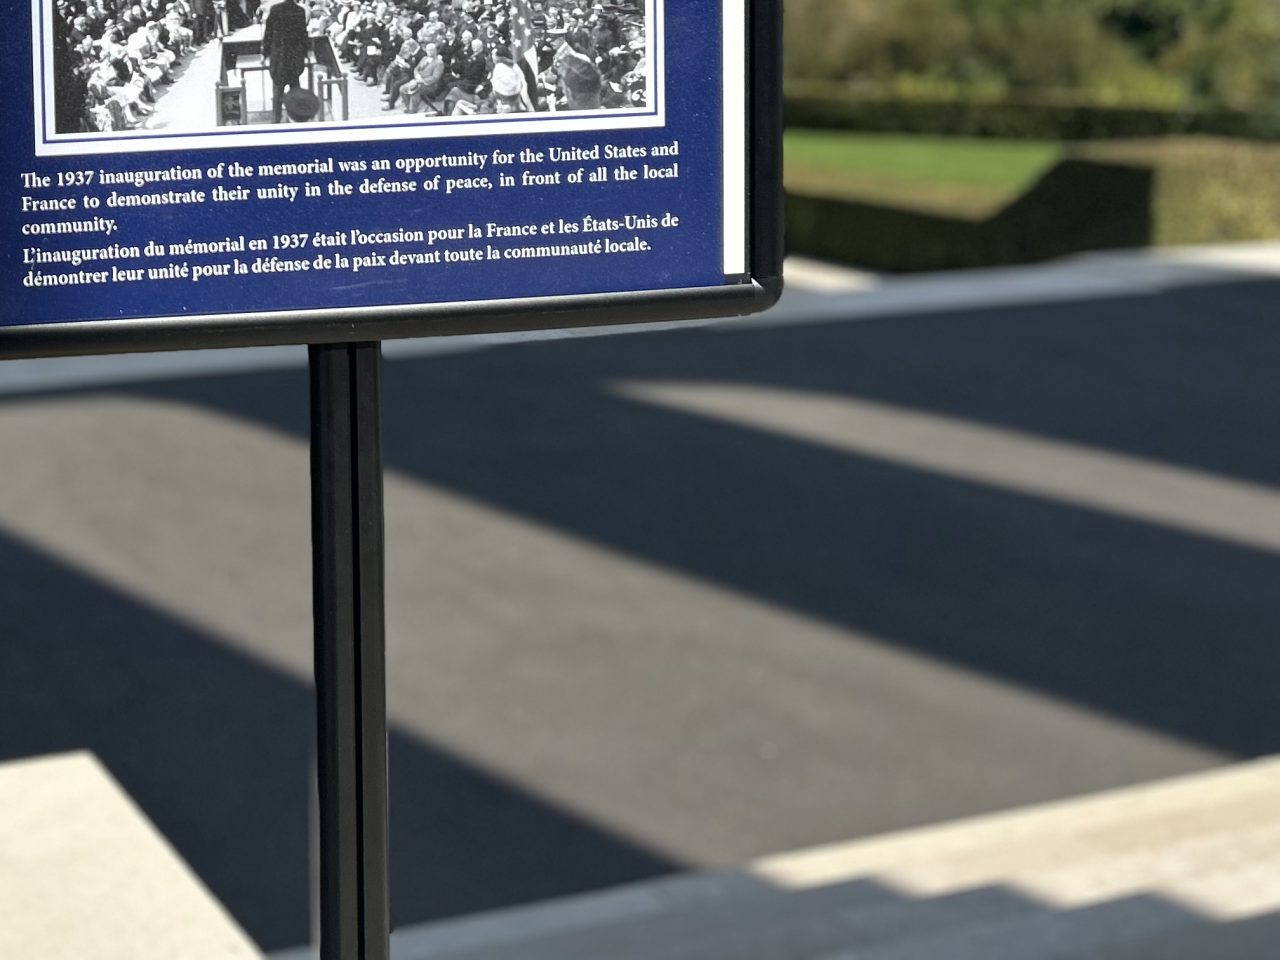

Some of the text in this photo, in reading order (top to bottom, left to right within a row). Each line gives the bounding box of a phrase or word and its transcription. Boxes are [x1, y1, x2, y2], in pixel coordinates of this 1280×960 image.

[21, 141, 679, 188] The 1937 inauguration of the memorial was an opportunity for the United States and
[22, 163, 679, 211] France to demonstrate their unity in the defense of peace, in front of all the local
[22, 216, 117, 235] community.
[23, 212, 679, 266] L’inauguration du mémorial en 1937 était l’occasion pour la France et les États-Unis de
[23, 236, 651, 287] démontrer leur unité pour la défense de la paix devant toute la communauté locale.
